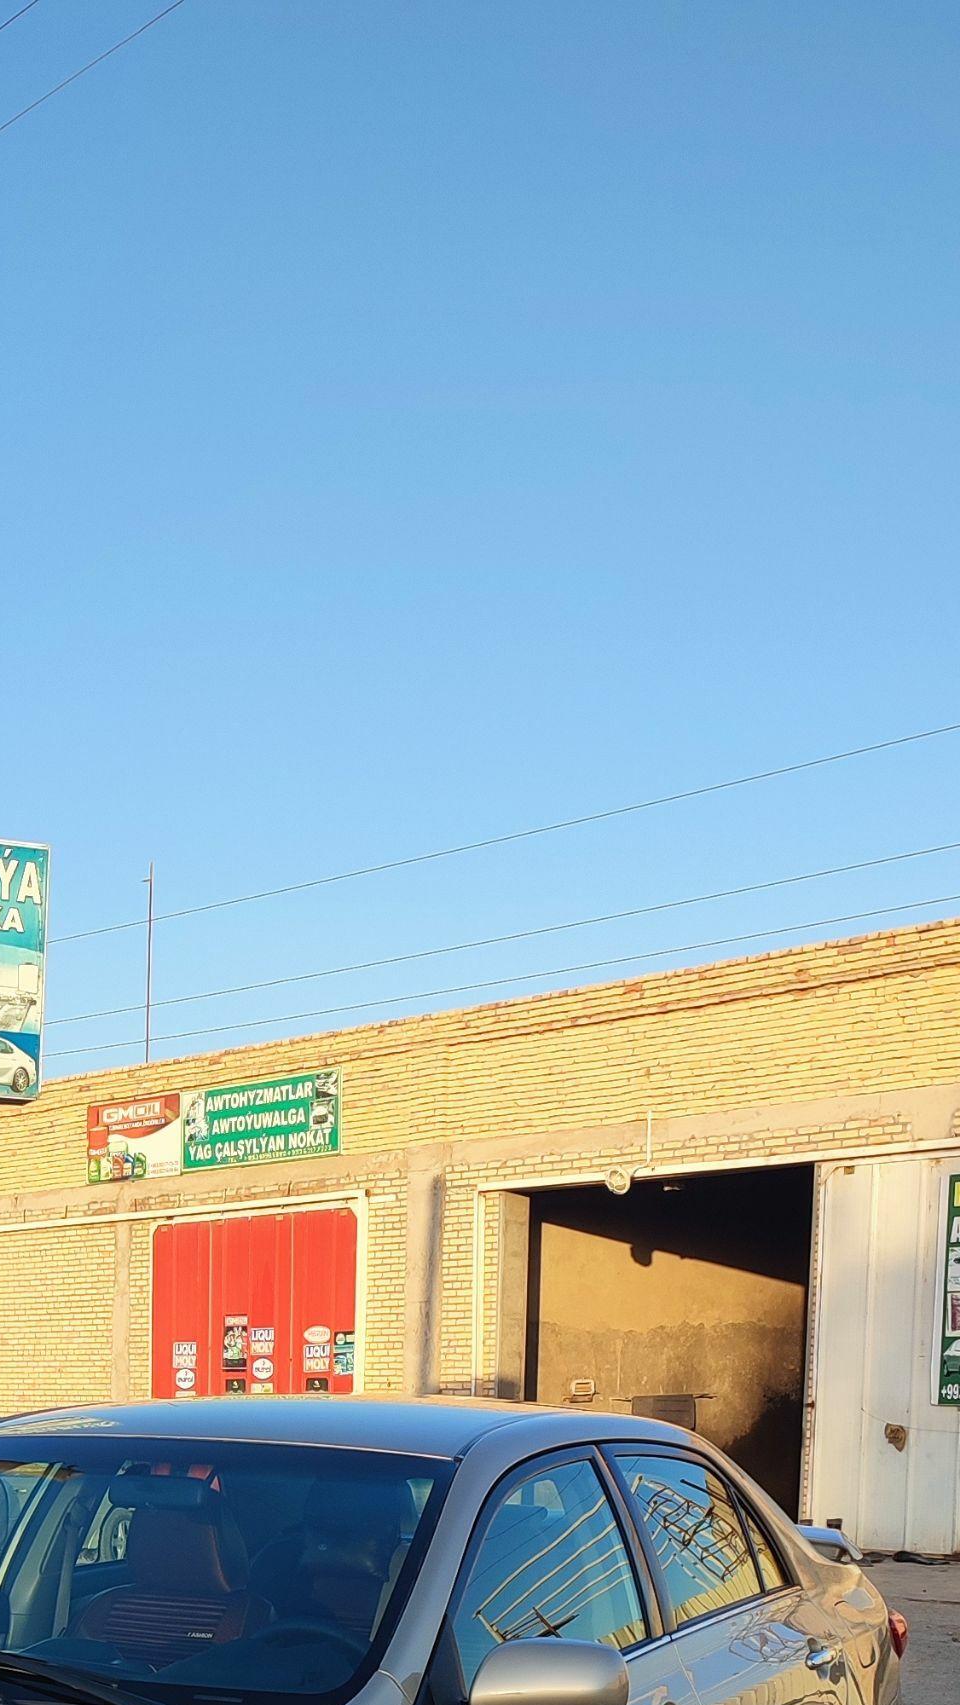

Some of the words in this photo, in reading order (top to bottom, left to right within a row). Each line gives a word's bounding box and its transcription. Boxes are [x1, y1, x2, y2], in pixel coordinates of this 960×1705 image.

[206, 1081, 313, 1112] AWTOHYZMATLAR
[212, 1106, 305, 1135] AWTOÝUWALGA
[288, 1128, 332, 1149] NOKAT
[251, 1342, 274, 1353] MOLY
[305, 1358, 330, 1370] MOLY
